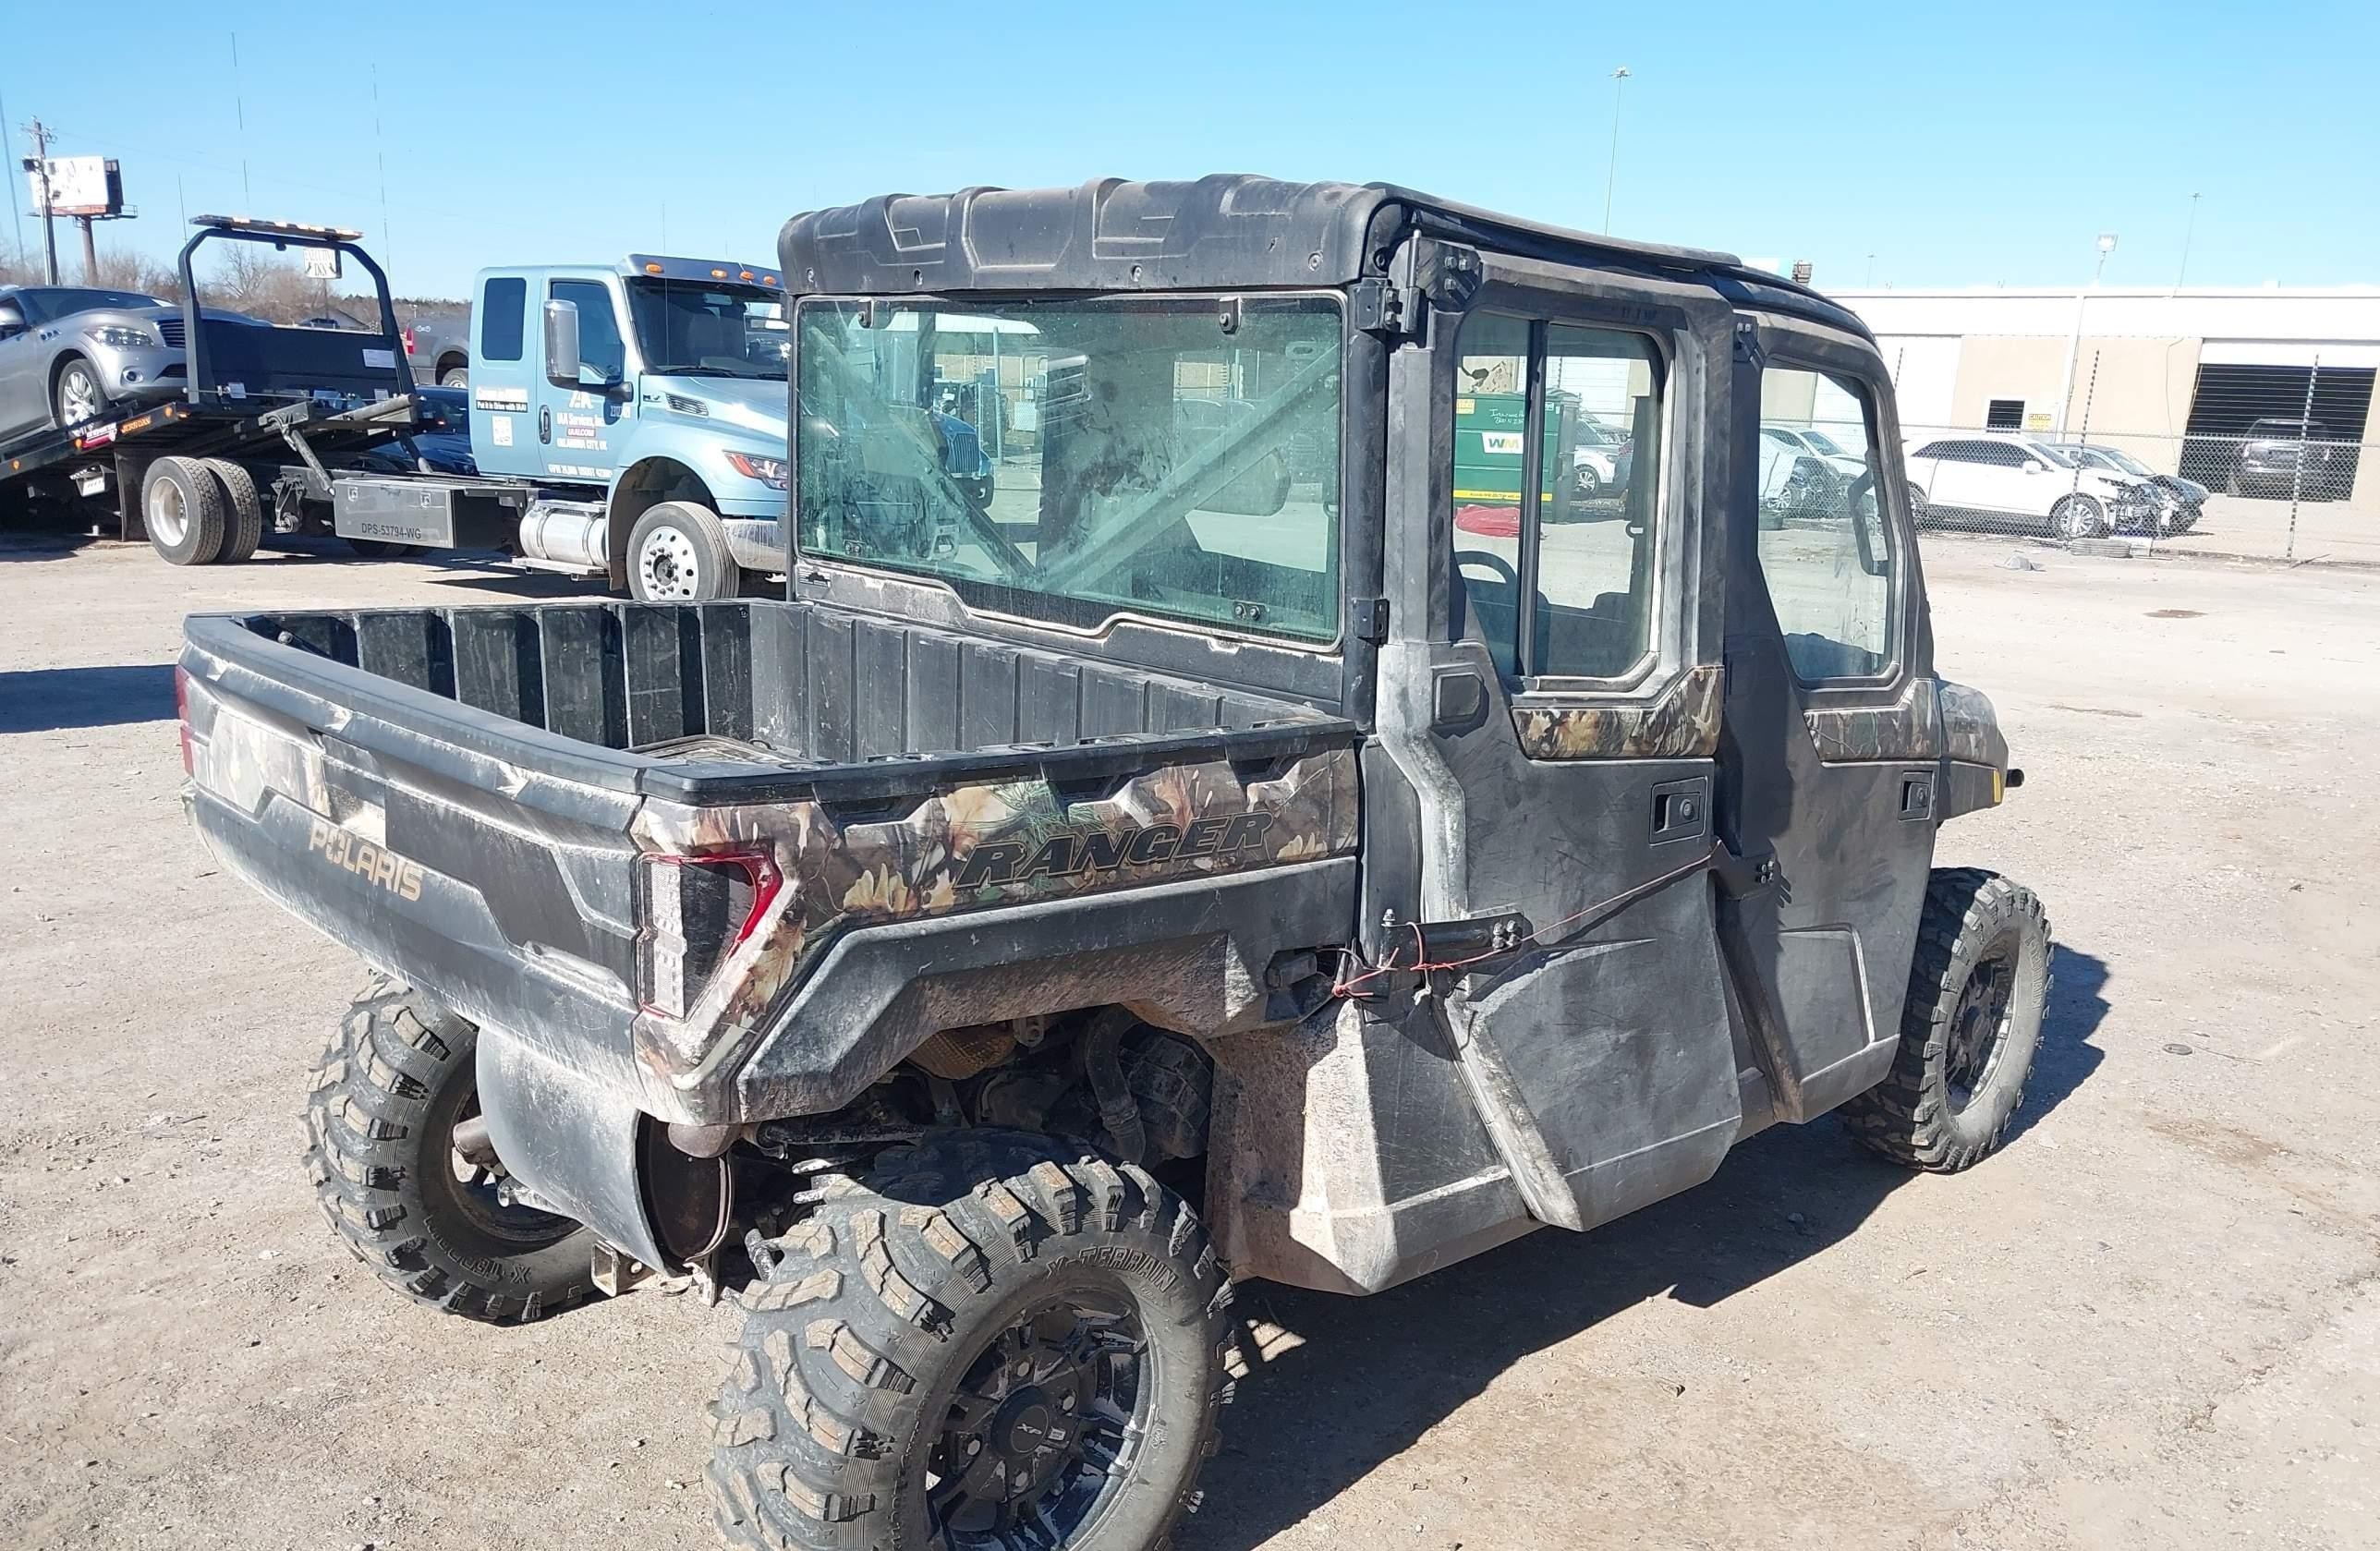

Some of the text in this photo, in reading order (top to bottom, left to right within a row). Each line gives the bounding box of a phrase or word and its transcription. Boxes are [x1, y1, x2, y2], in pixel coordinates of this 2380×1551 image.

[1488, 437, 1520, 450] WM
[361, 523, 422, 539] DPS-53794-WG
[309, 816, 423, 903] POLARIS
[952, 810, 1275, 890] RANGER
[1045, 1245, 1180, 1294] X-TERRAIN
